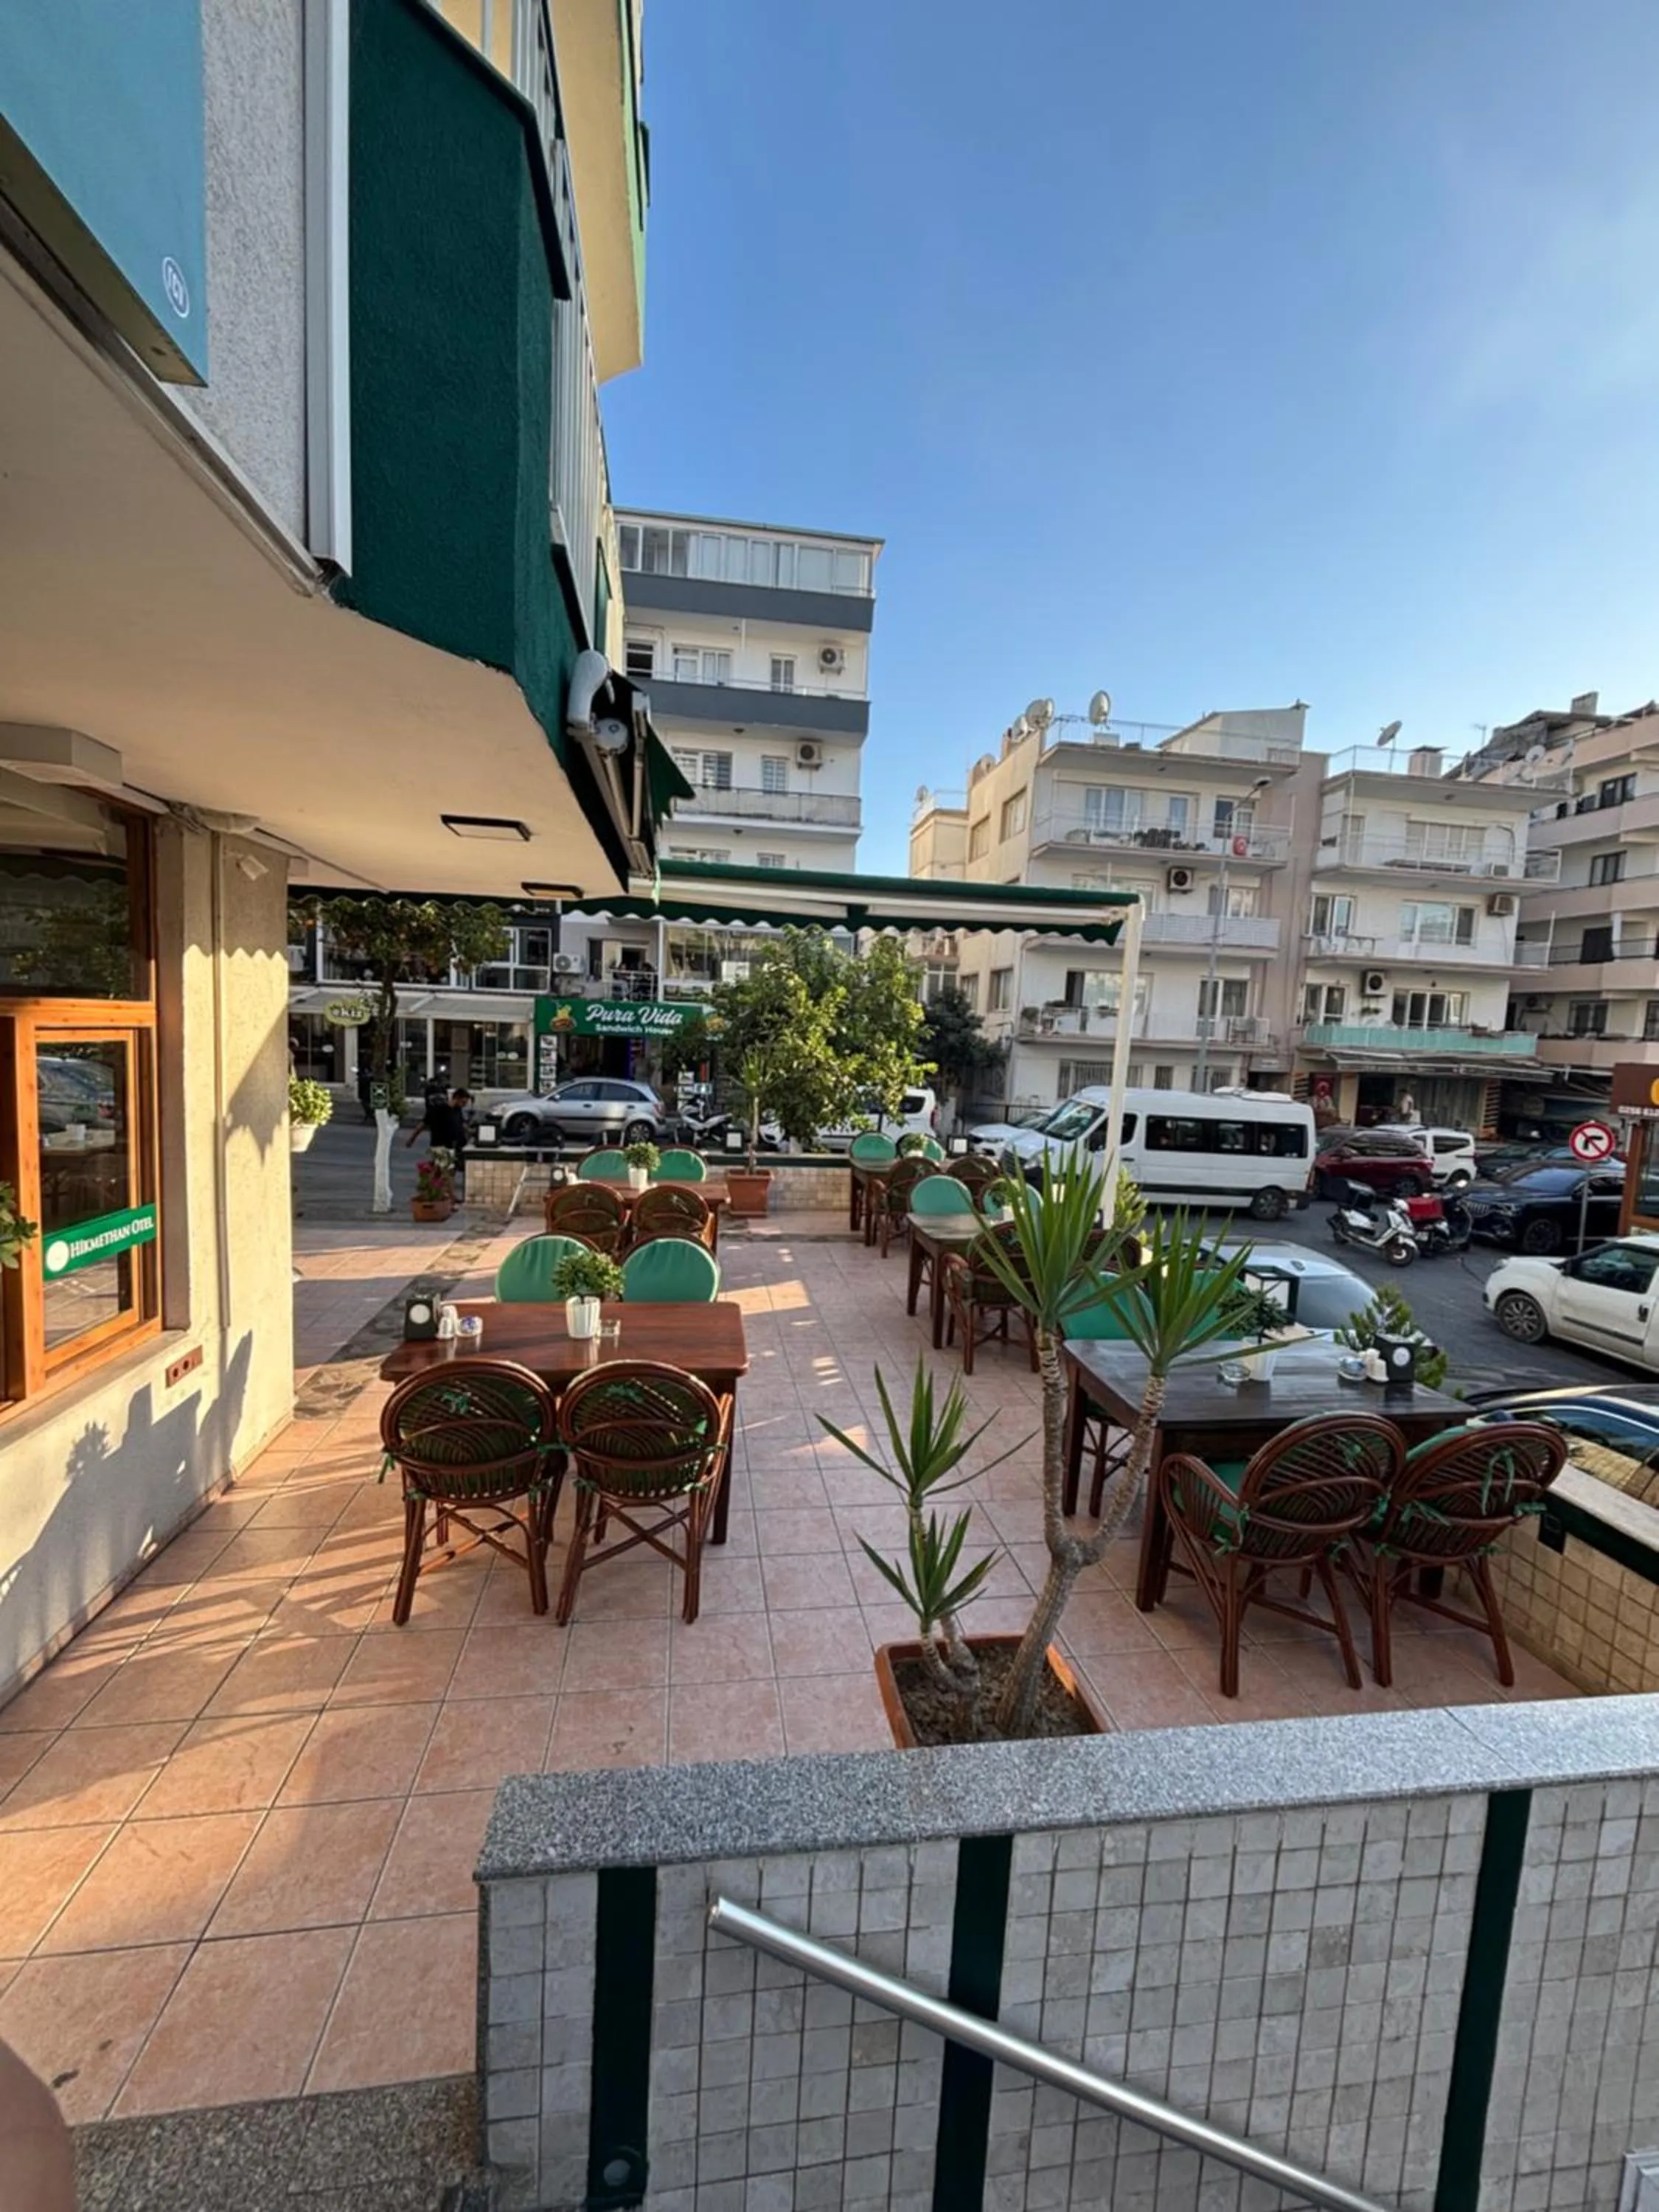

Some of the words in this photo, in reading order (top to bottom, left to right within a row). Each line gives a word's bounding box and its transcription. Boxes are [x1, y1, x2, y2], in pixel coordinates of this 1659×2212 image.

[585, 1004, 636, 1022] Pura
[638, 1006, 684, 1025] Vida
[595, 1023, 643, 1032] Sandwich
